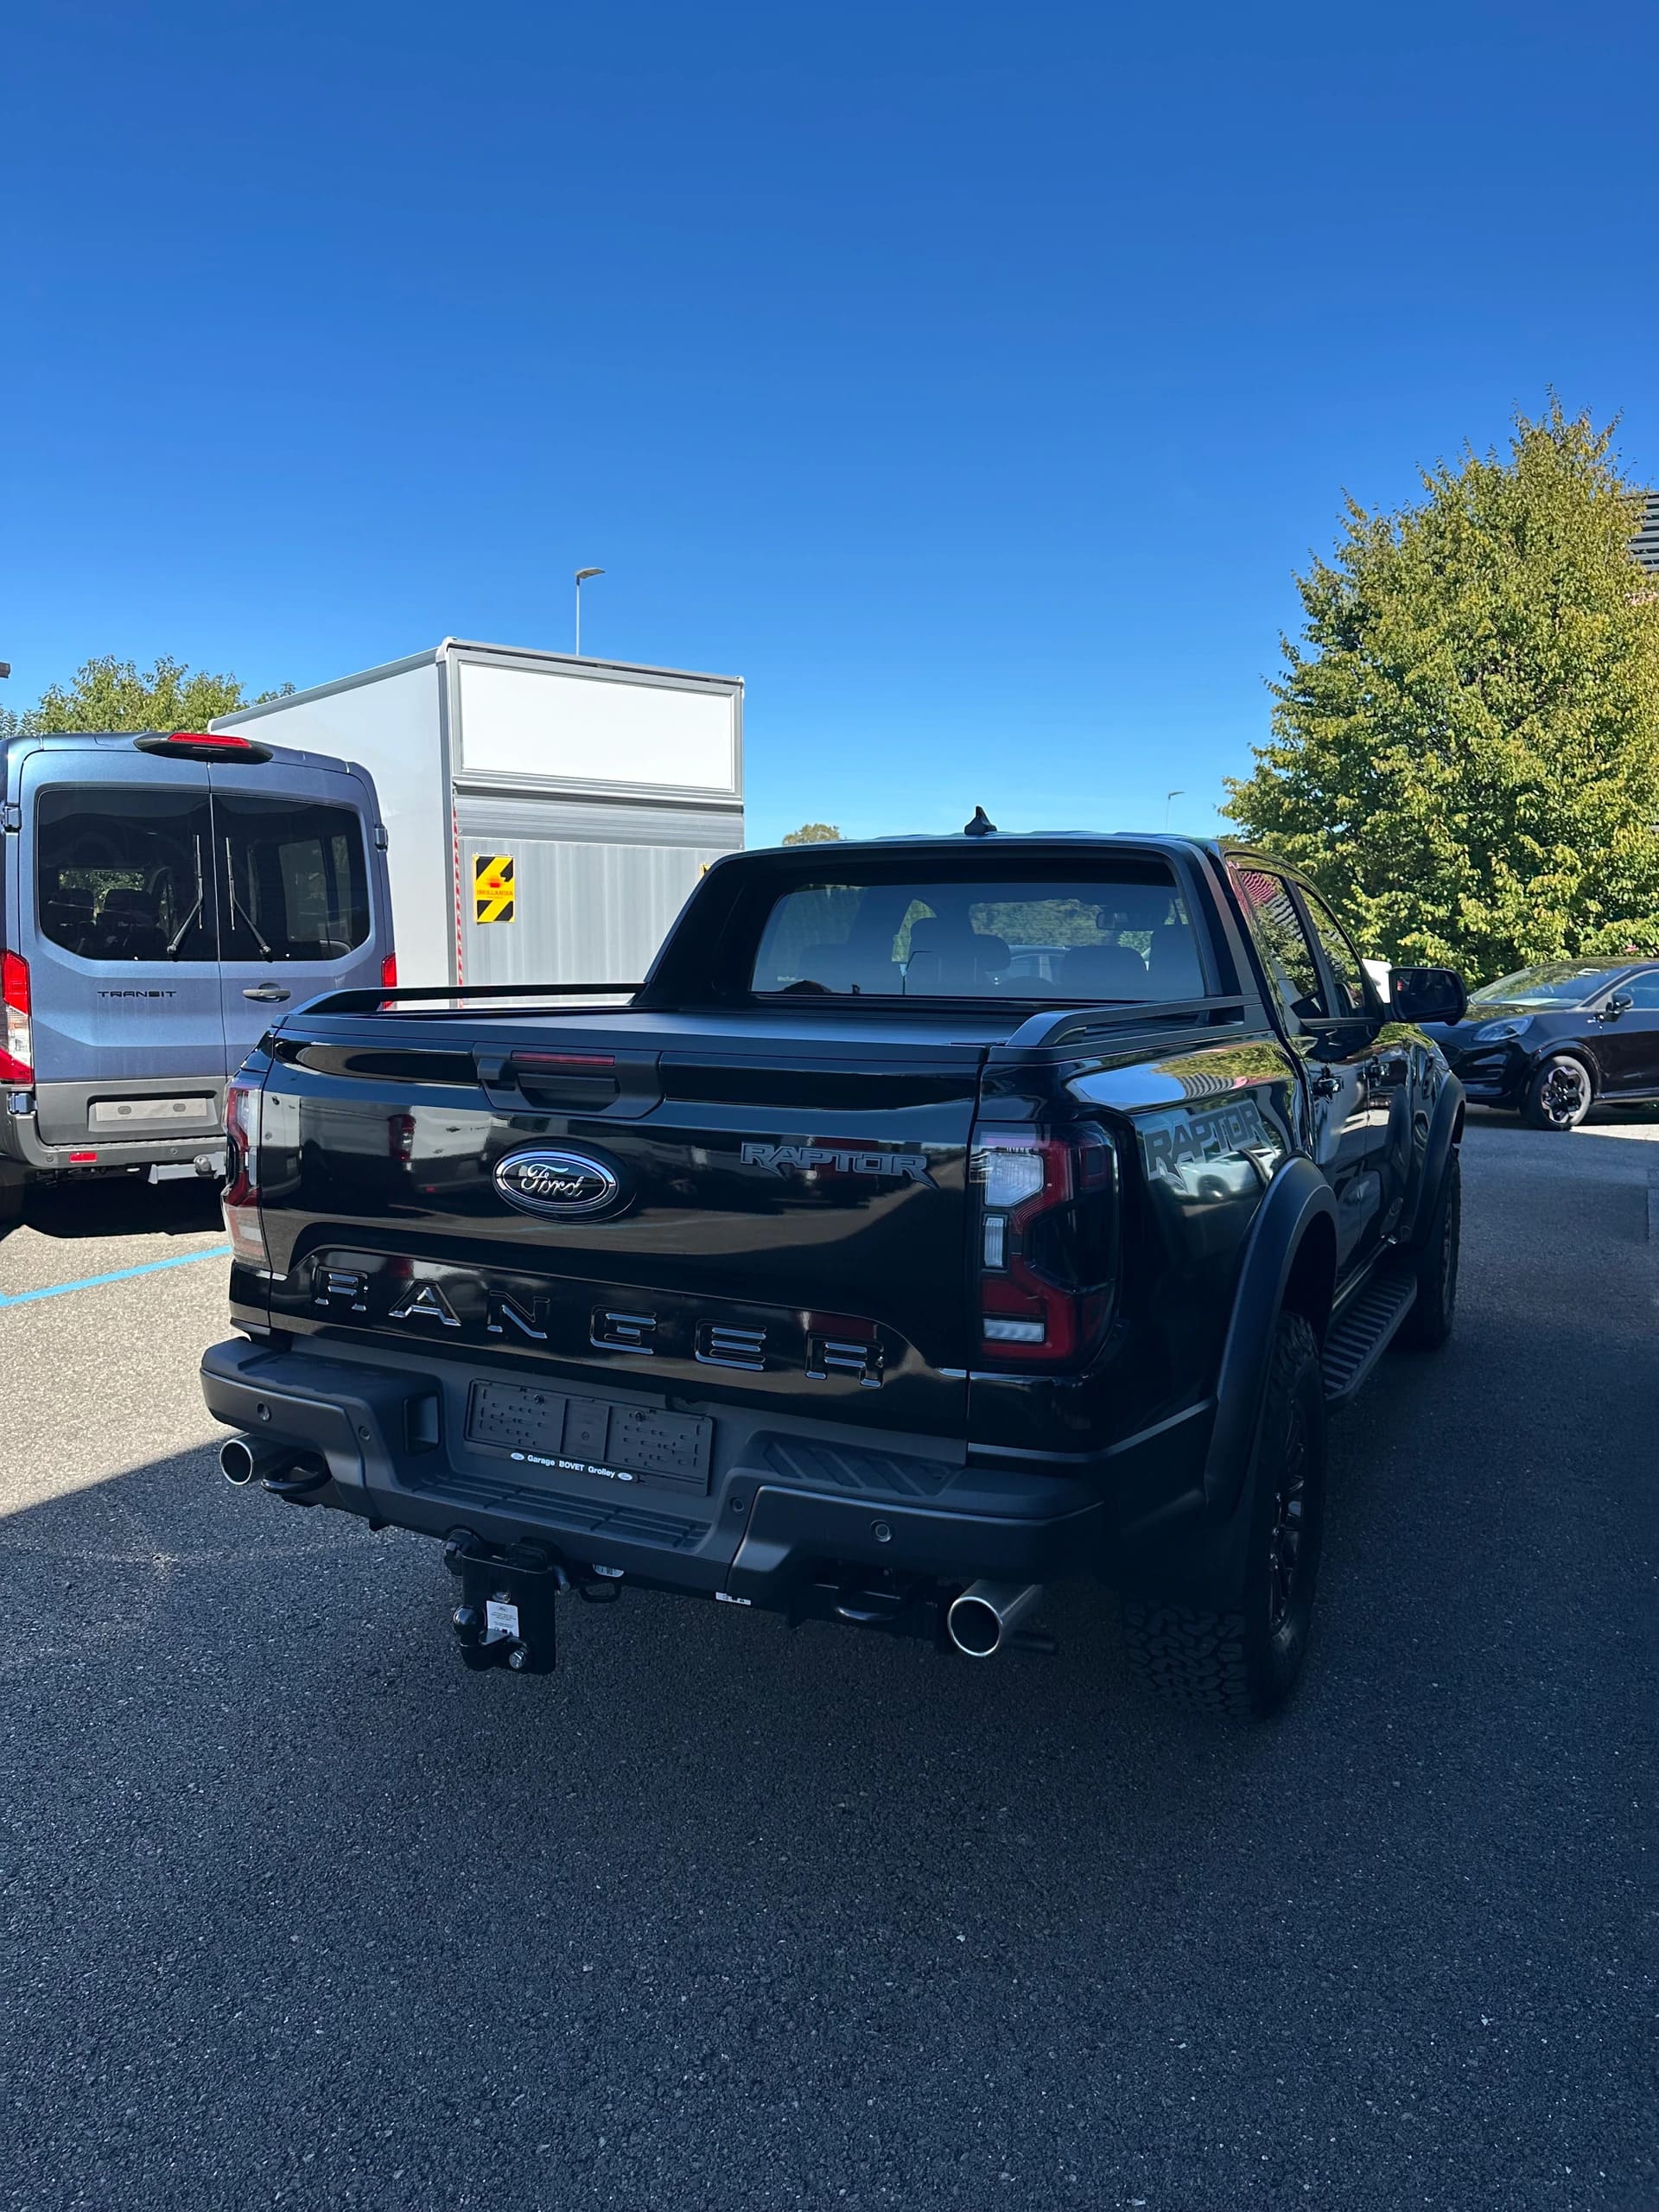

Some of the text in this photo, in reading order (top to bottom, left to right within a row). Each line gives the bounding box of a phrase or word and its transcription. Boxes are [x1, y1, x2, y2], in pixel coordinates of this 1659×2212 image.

[741, 1141, 940, 1190] RAPTOR
[1143, 1098, 1278, 1193] RAPTOR
[520, 1163, 585, 1198] Ford
[313, 1265, 884, 1389] RANGER
[527, 1454, 556, 1466] Garage
[558, 1460, 585, 1471] BOVET
[588, 1465, 616, 1478] Grolley
